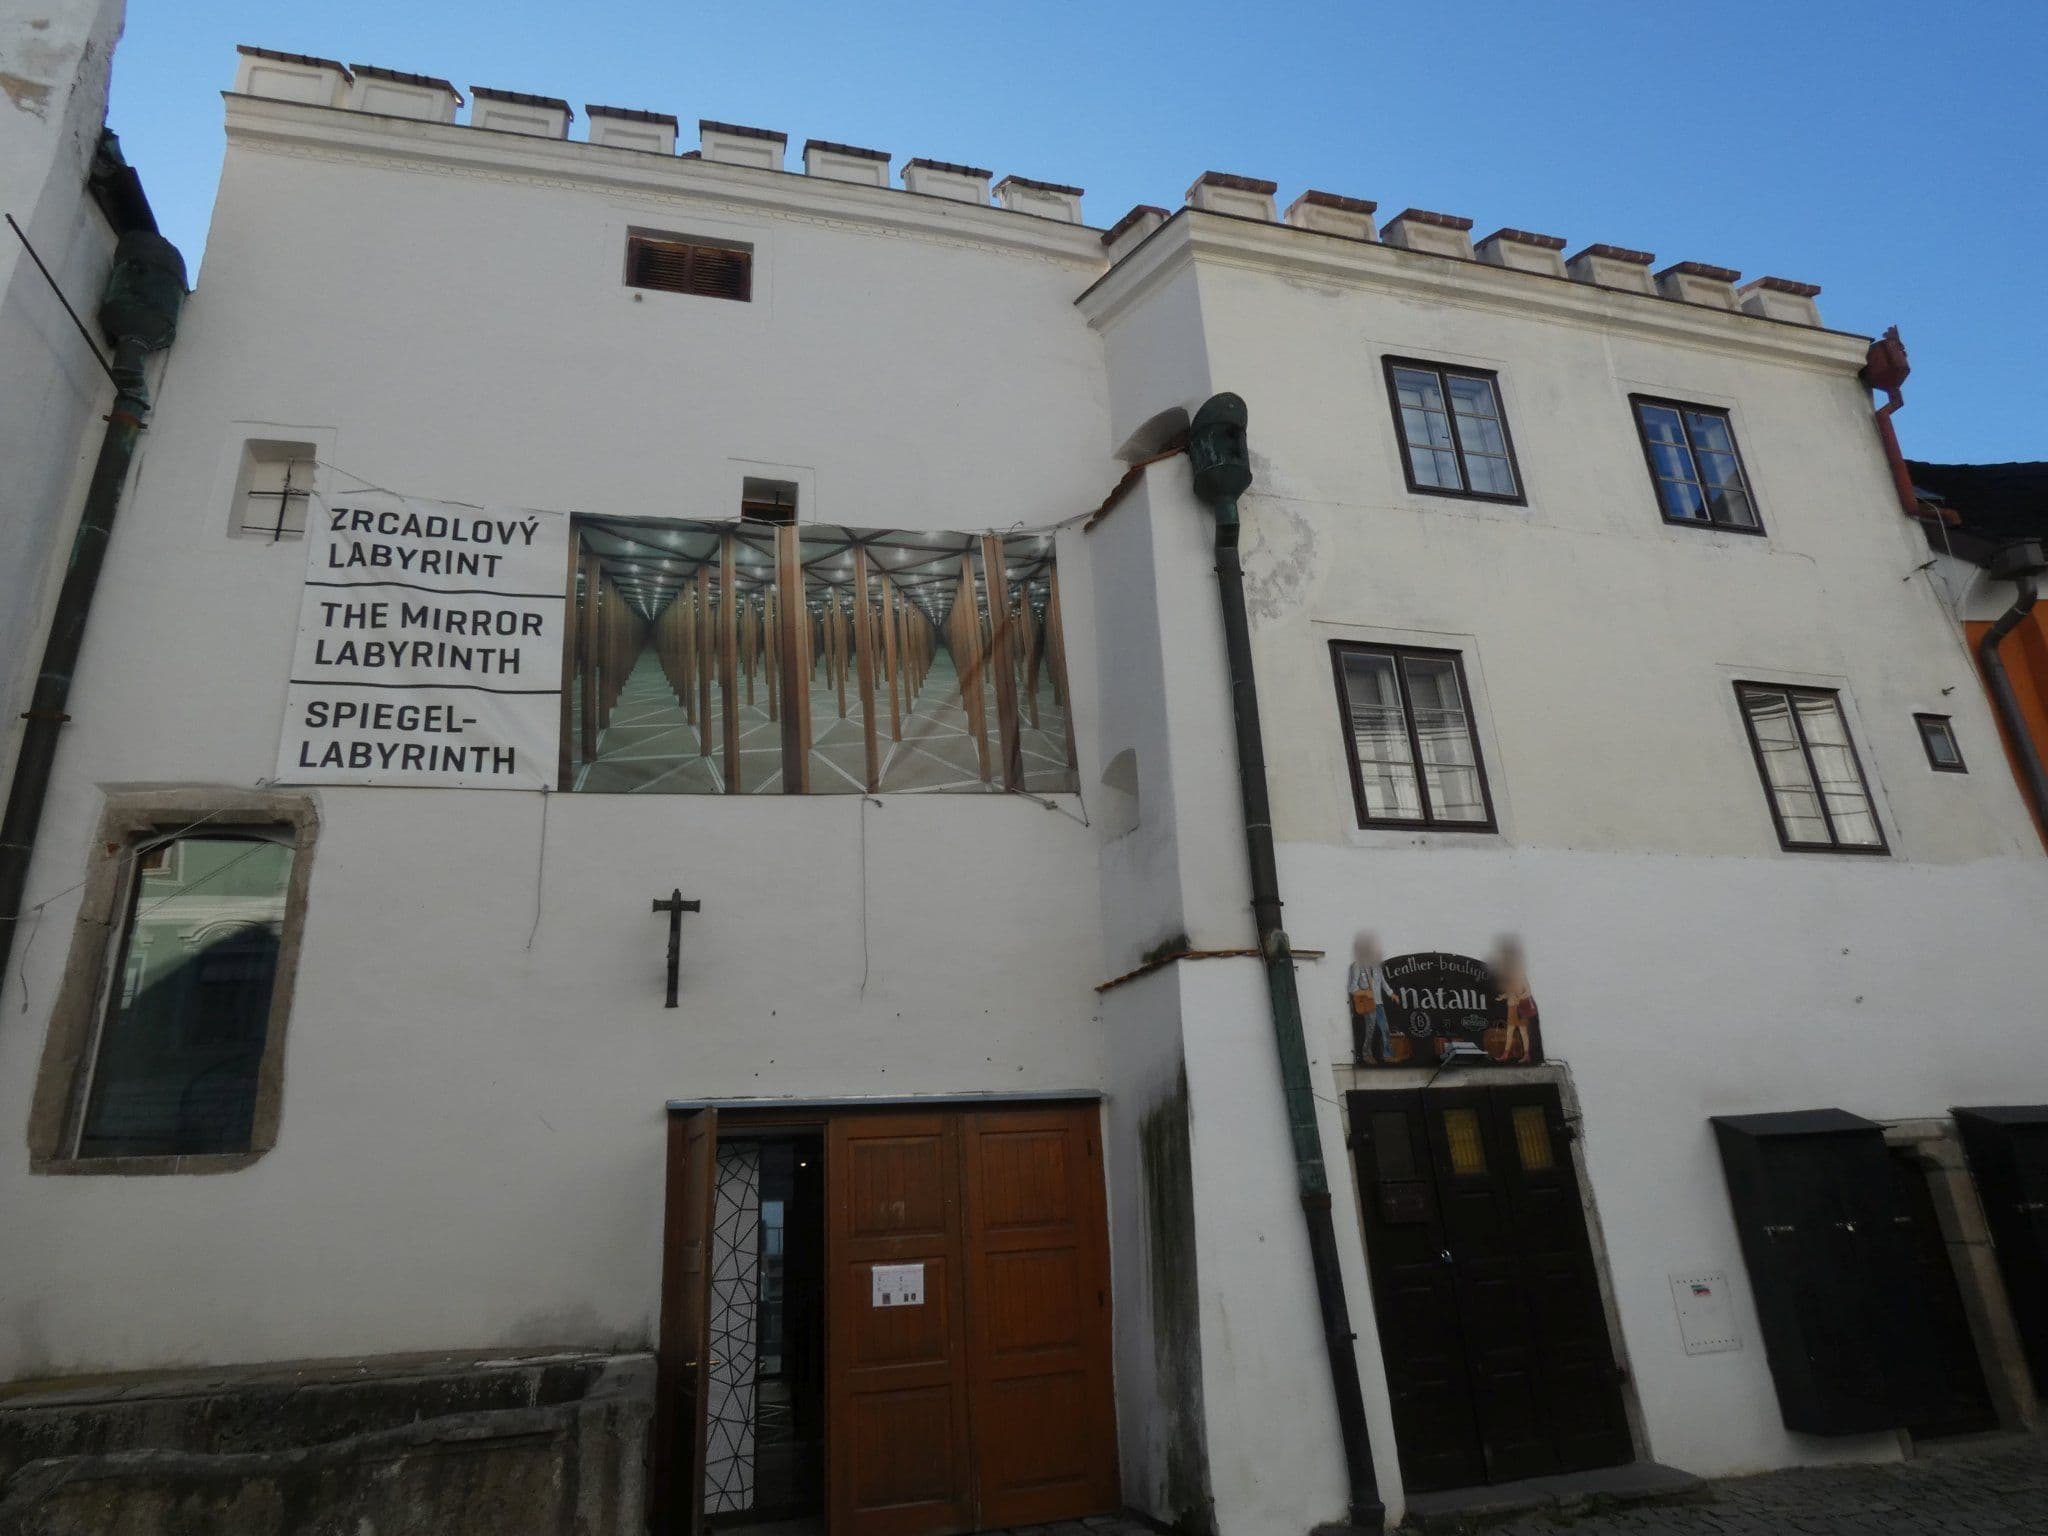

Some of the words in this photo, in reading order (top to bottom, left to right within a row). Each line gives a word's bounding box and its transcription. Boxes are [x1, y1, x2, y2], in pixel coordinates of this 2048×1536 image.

[330, 507, 540, 546] ZRCADLOVÝ
[328, 541, 503, 578] LABYRINT
[320, 601, 389, 629] THE
[401, 602, 543, 637] MIRROR
[315, 639, 520, 675] LABYRINTH
[305, 700, 477, 733] SPIEGEL-
[299, 740, 515, 775] LABYRINTH
